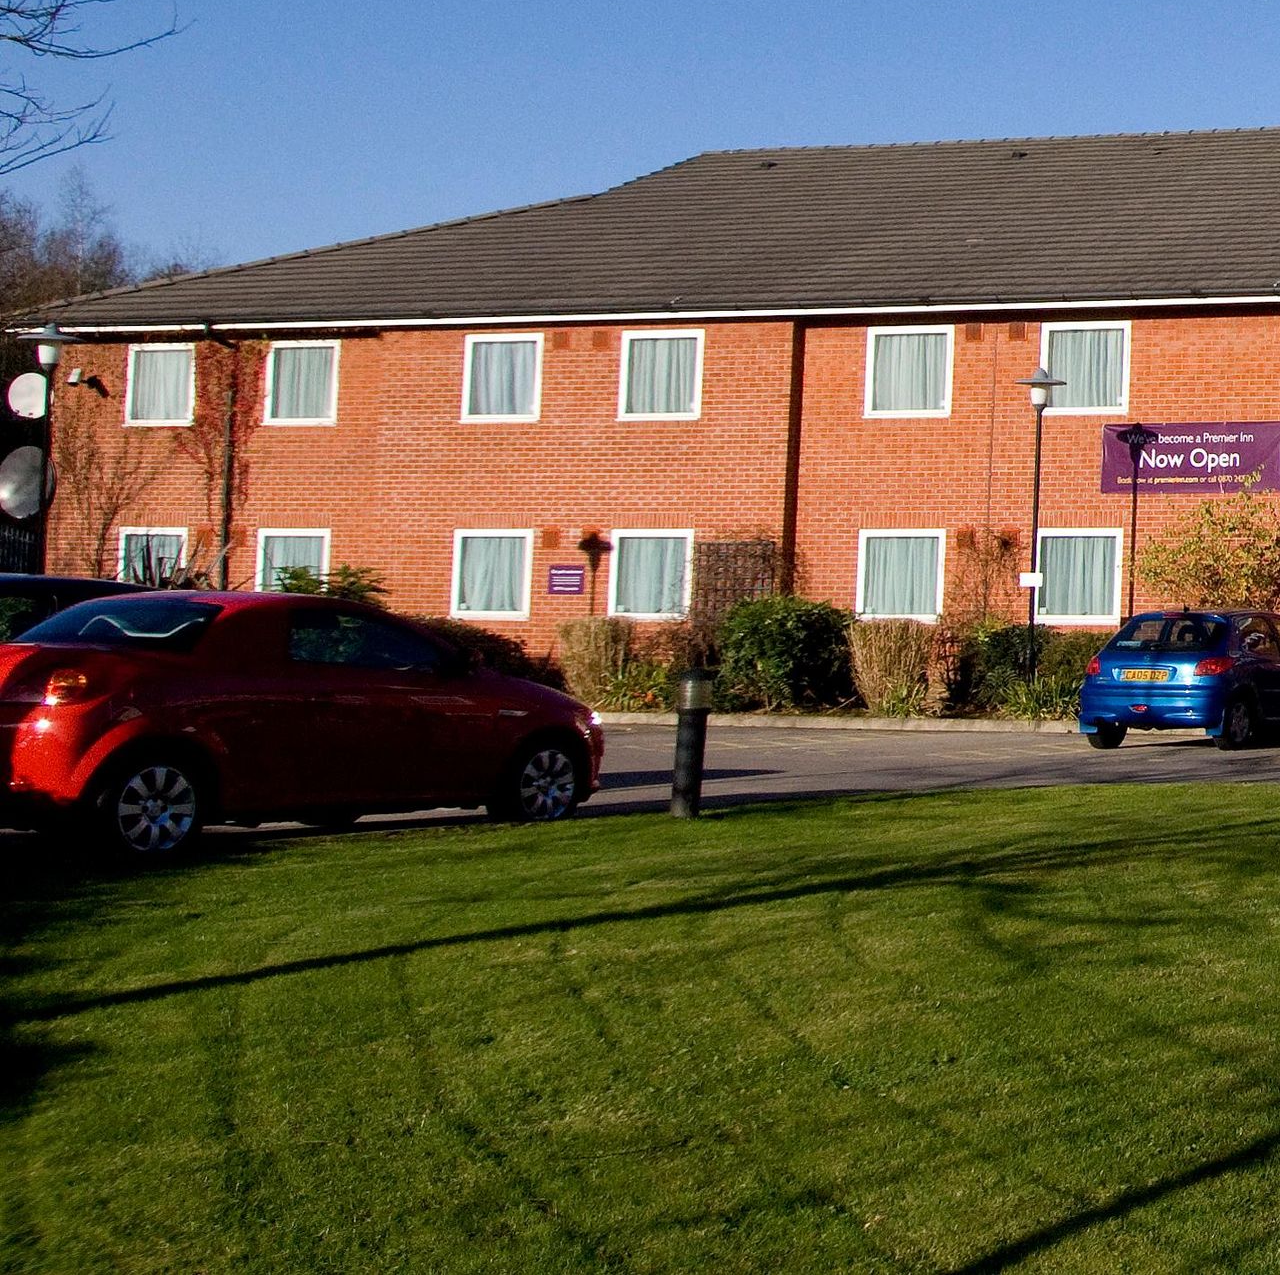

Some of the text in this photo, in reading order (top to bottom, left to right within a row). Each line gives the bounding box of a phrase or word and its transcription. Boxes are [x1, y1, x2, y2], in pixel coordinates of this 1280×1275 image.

[1158, 433, 1194, 444] become
[1195, 435, 1202, 443] a
[1203, 432, 1239, 443] Premier
[1240, 431, 1254, 443] Inn
[1139, 447, 1240, 473] Now Open
